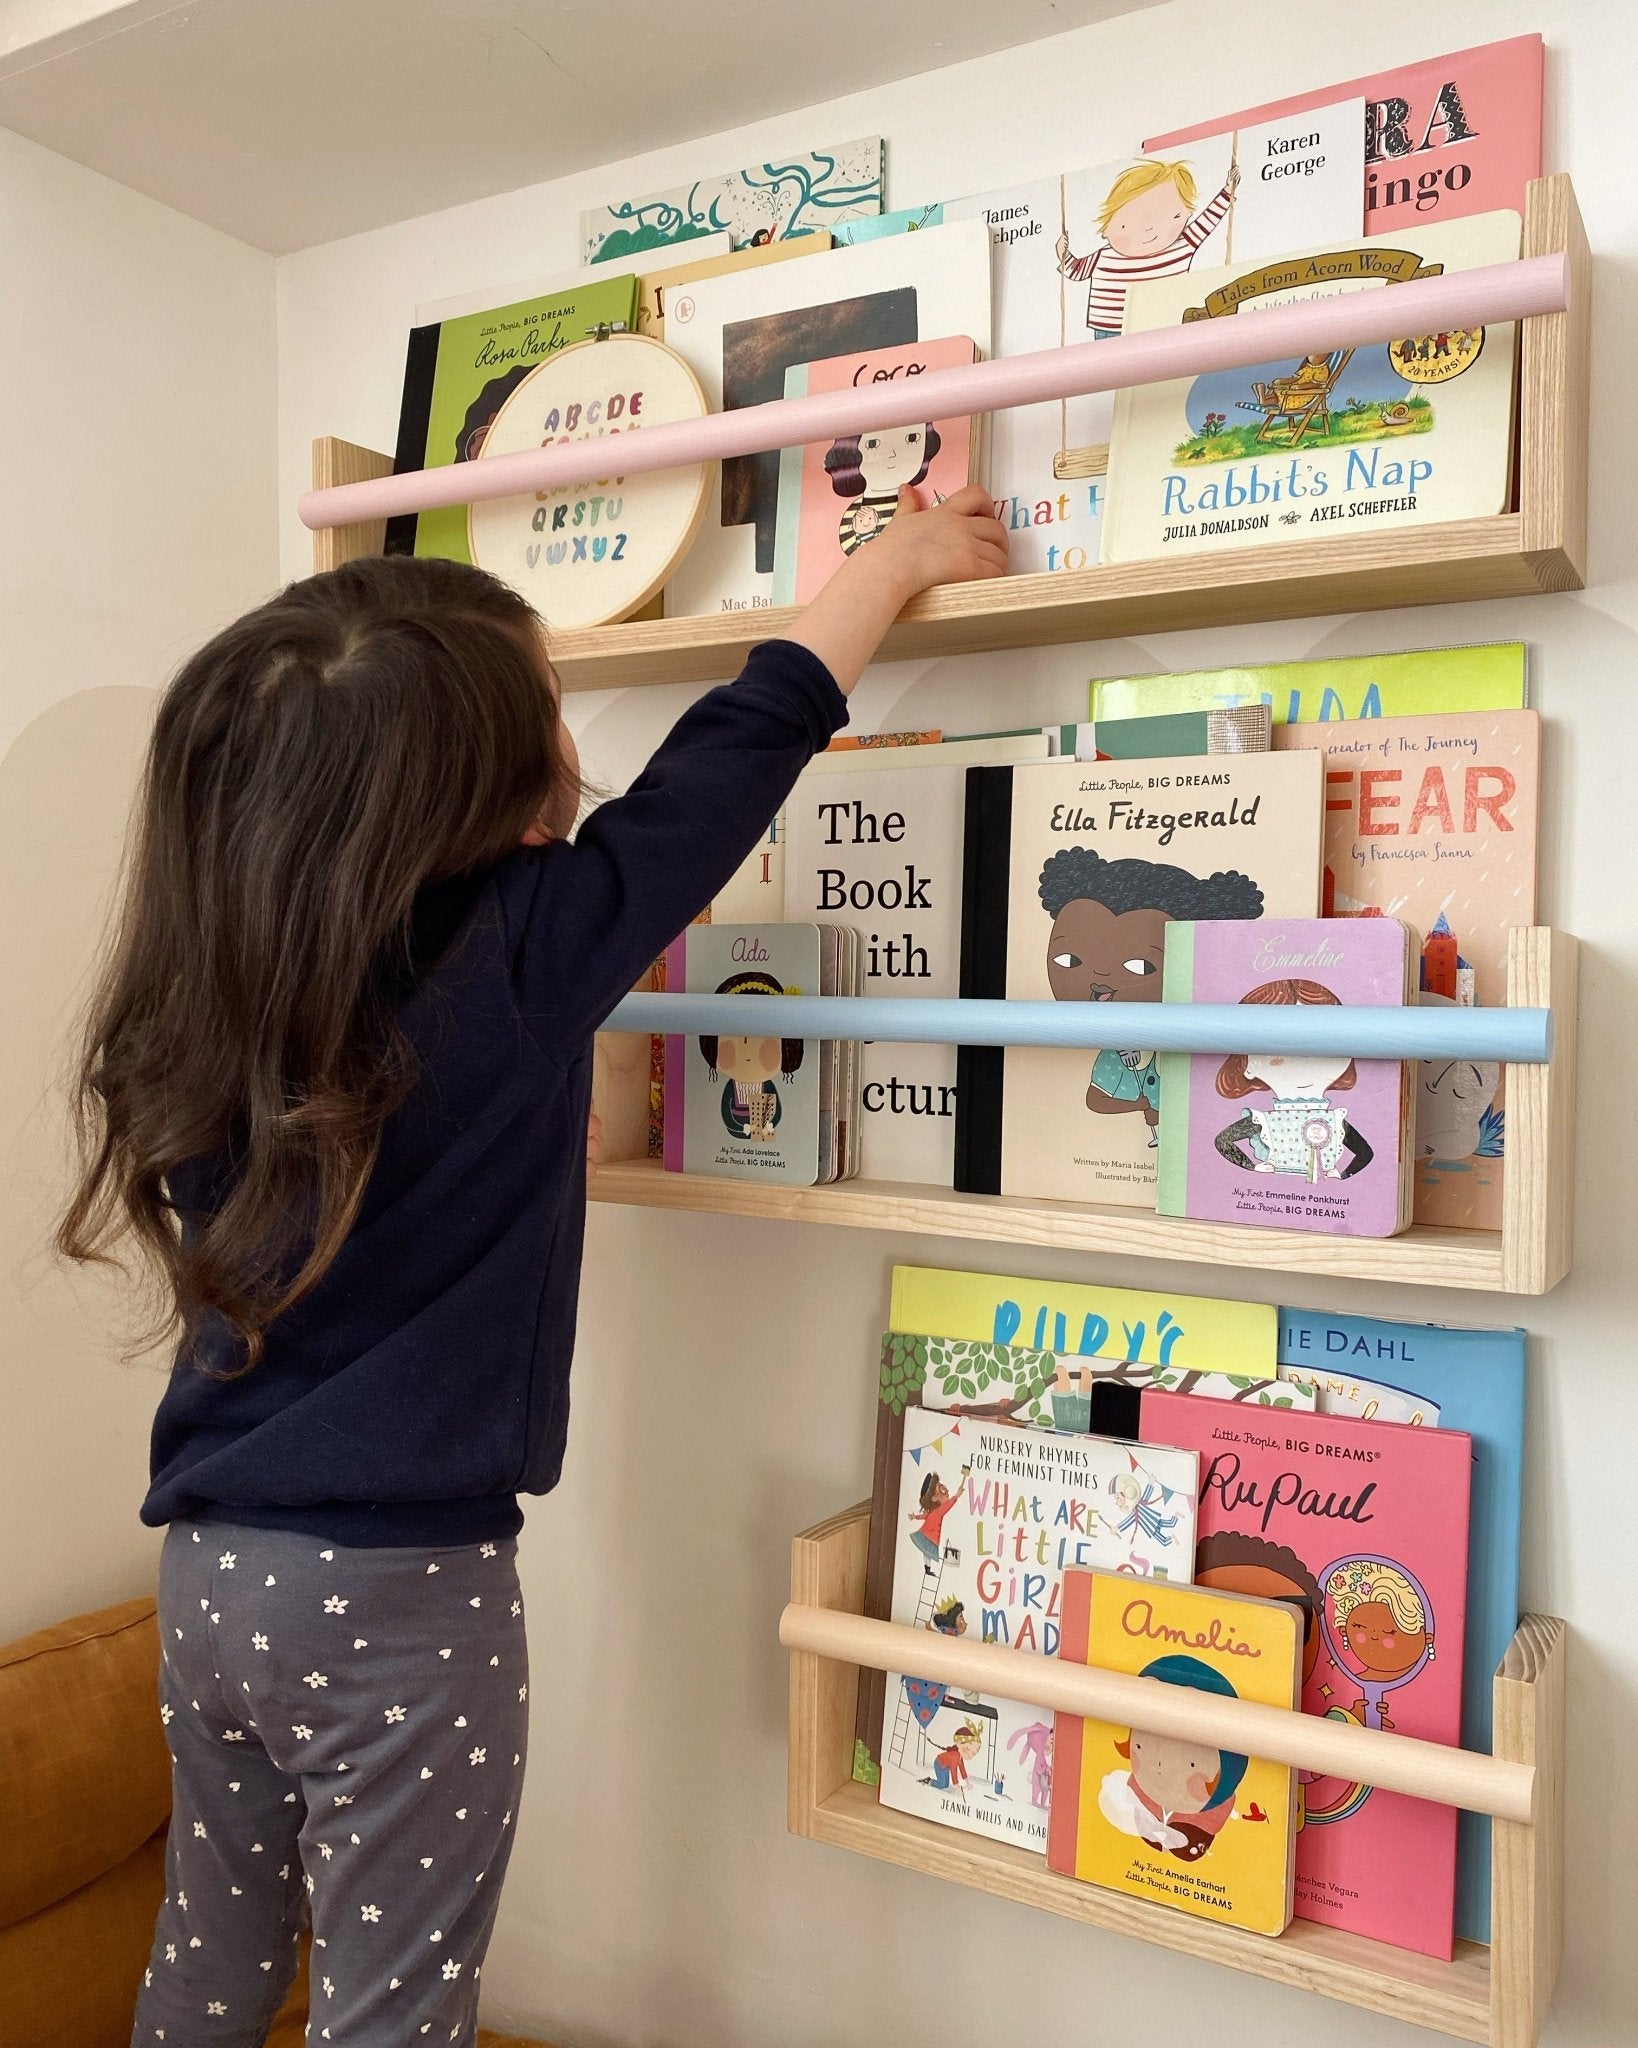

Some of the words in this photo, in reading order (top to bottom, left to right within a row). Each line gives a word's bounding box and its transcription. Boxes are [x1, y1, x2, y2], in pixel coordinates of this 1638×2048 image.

[1267, 132, 1321, 157] Karen
[1261, 155, 1326, 183] George
[982, 205, 1030, 225] James
[1216, 282, 1257, 305] Tales
[1262, 268, 1298, 289] from
[1305, 260, 1352, 278] Acorn
[1358, 254, 1405, 275] Wood
[480, 326, 498, 337] Little
[523, 315, 539, 326] BIG
[541, 305, 576, 322] DREAMS
[474, 338, 520, 368] Rosa
[520, 320, 570, 358] Parks
[1161, 458, 1328, 516] Rabbit's
[1343, 446, 1434, 495] Nap
[1163, 523, 1197, 542] JULIA
[1200, 514, 1270, 536] DONALDSON
[1310, 505, 1345, 522] AXEL
[1348, 496, 1417, 518] SCHEFFLER
[1046, 544, 1088, 572] to
[720, 598, 748, 612] Mac
[1328, 741, 1373, 755] creator
[1379, 738, 1391, 757] of
[1399, 736, 1419, 752] The
[1424, 735, 1478, 755] Journey
[1078, 780, 1107, 792] Little
[1108, 779, 1144, 794] People,
[1148, 777, 1171, 788] BIG
[1175, 773, 1231, 787] DREAMS
[818, 800, 906, 845] The
[1050, 804, 1097, 832] Ella
[1108, 795, 1261, 846] Fitzgerald
[1351, 843, 1365, 867] by
[1371, 844, 1430, 862] Francesca
[1433, 841, 1475, 863] Sanna
[816, 865, 932, 911] Book
[731, 937, 770, 962] Ada
[1252, 934, 1346, 973] Emmeline
[742, 1147, 754, 1156] Ada
[755, 1149, 780, 1157] Lovelace
[747, 1159, 758, 1167] BIG
[760, 1160, 786, 1169] DREAMS
[1073, 1158, 1099, 1167] Written
[1101, 1159, 1110, 1168] by
[1111, 1160, 1132, 1169] Maria
[1133, 1161, 1155, 1171] Isabel
[1095, 1172, 1131, 1182] Illustrated
[1132, 1174, 1142, 1184] by
[1232, 1187, 1245, 1199] My
[1246, 1189, 1264, 1198] First
[1265, 1190, 1306, 1202] Emmeline
[1308, 1194, 1350, 1206] Pankhurst
[1236, 1201, 1256, 1211] Little
[1285, 1206, 1302, 1215] BIG
[1305, 1207, 1346, 1219] DREAMS
[1326, 1330, 1415, 1362] DAHL
[980, 1435, 1032, 1458] NURSERY
[1039, 1445, 1089, 1467] RHYMES
[1211, 1427, 1241, 1442] Little
[1243, 1432, 1281, 1450] People,
[1285, 1439, 1310, 1453] BIG
[970, 1453, 991, 1471] FOR
[997, 1457, 1054, 1482] FEMINIST
[1061, 1468, 1098, 1490] TIMES
[1053, 1498, 1100, 1539] ARE
[1122, 1599, 1261, 1658] Amelia
[940, 1798, 971, 1817] JEANNE
[975, 1808, 1002, 1826] WILLIS
[1005, 1817, 1024, 1832] AND
[1125, 1870, 1145, 1884] Little
[1173, 1885, 1190, 1897] BIG
[1193, 1891, 1233, 1911] DREAMS
[1131, 1859, 1145, 1872] My
[1146, 1862, 1163, 1875] First
[1165, 1868, 1194, 1885] Amelia
[1196, 1878, 1226, 1894] Earhart
[1328, 1882, 1359, 1898] Vegara
[1310, 1892, 1343, 1909] Holmes
